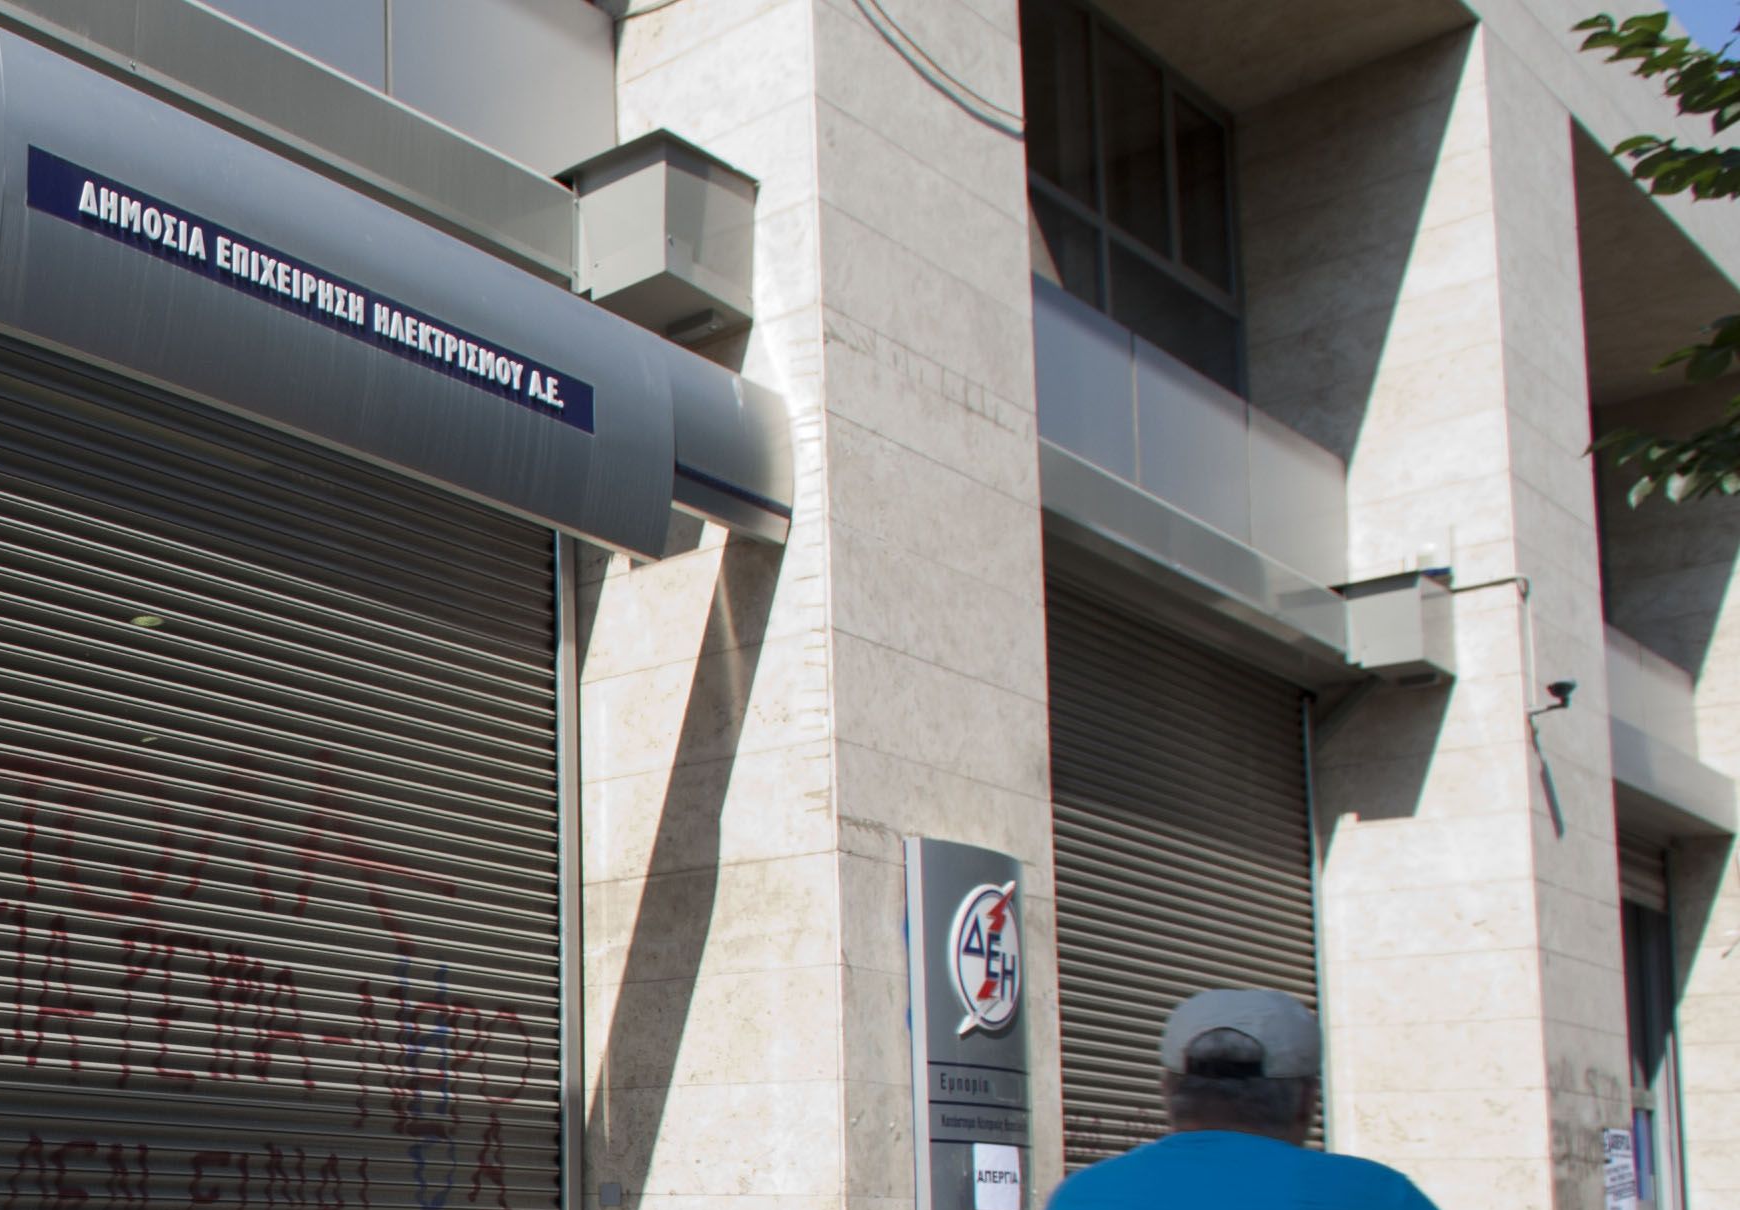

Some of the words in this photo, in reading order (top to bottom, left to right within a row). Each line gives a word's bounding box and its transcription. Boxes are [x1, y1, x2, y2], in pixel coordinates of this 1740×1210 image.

[79, 181, 206, 260] ΔΗΜΟΣΙΑ
[217, 236, 364, 325] ΕΠΙΧΕΙΡΗΣΗ
[374, 303, 523, 390] ΗΛΕΚΤΡΙΣΜΟΥ
[529, 371, 564, 408] Α.Ε.
[963, 914, 1016, 1001] ΔΕΗ
[977, 1170, 1018, 1184] ΑΠΕΡΓΙΑ
